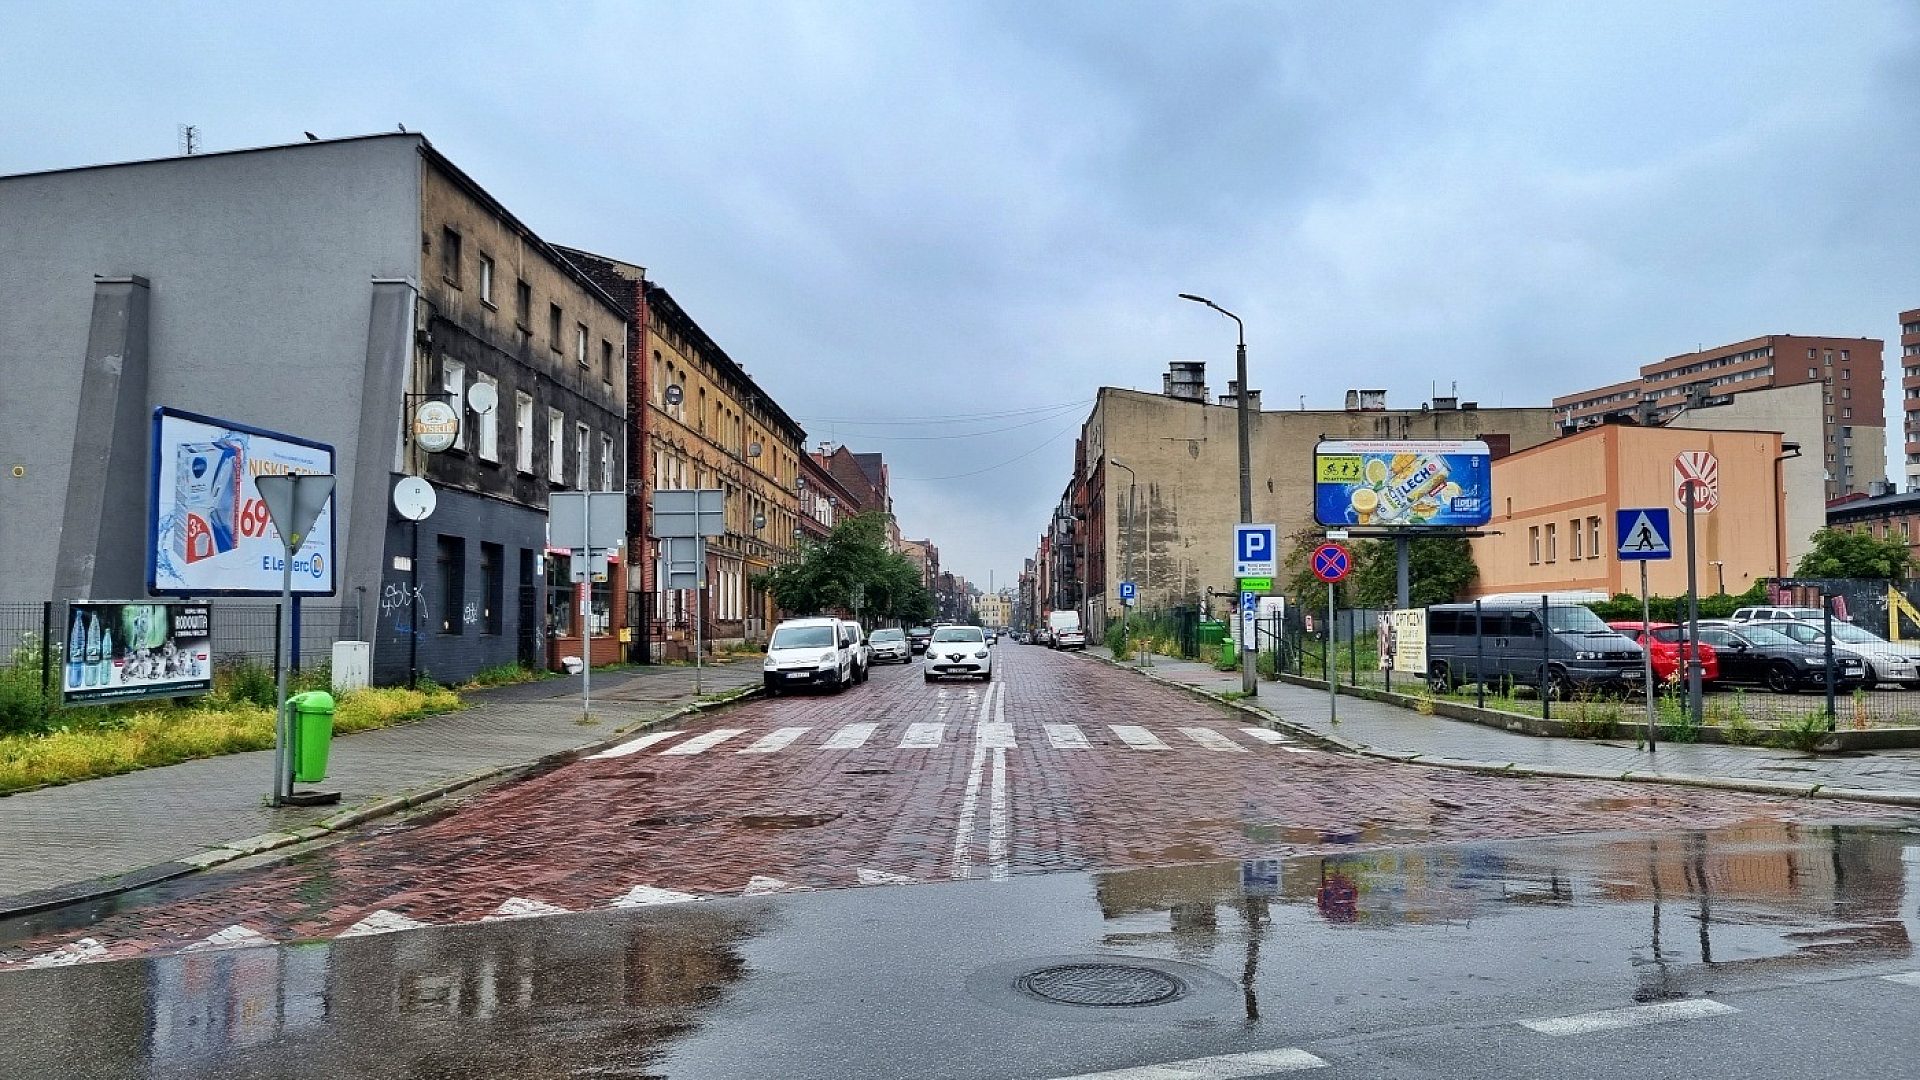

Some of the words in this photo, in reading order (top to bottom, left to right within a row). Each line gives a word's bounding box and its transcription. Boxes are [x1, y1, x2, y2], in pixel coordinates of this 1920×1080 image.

[1401, 467, 1431, 493] LECH
[1246, 533, 1265, 558] P
[1124, 585, 1133, 596] P
[1244, 592, 1253, 604] P
